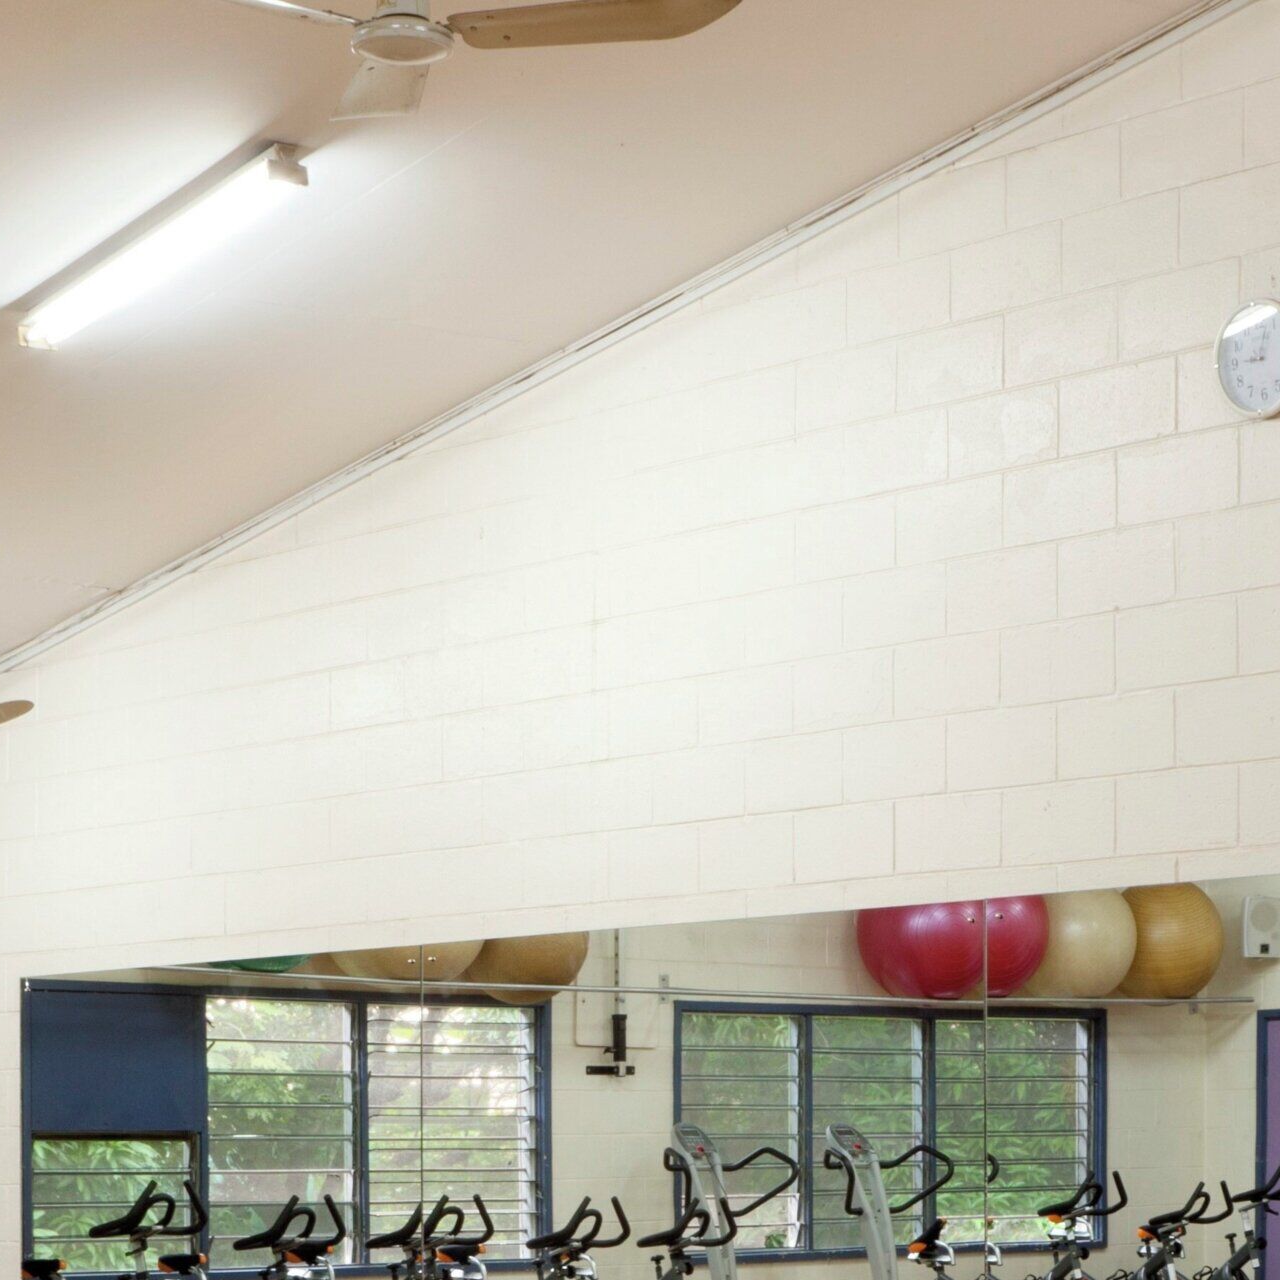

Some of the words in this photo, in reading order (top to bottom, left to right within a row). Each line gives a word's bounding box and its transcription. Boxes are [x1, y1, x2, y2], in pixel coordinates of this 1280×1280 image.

[1231, 357, 1239, 371] 9
[1236, 374, 1244, 388] 8
[1247, 385, 1254, 398] 7
[1260, 387, 1269, 401] 6
